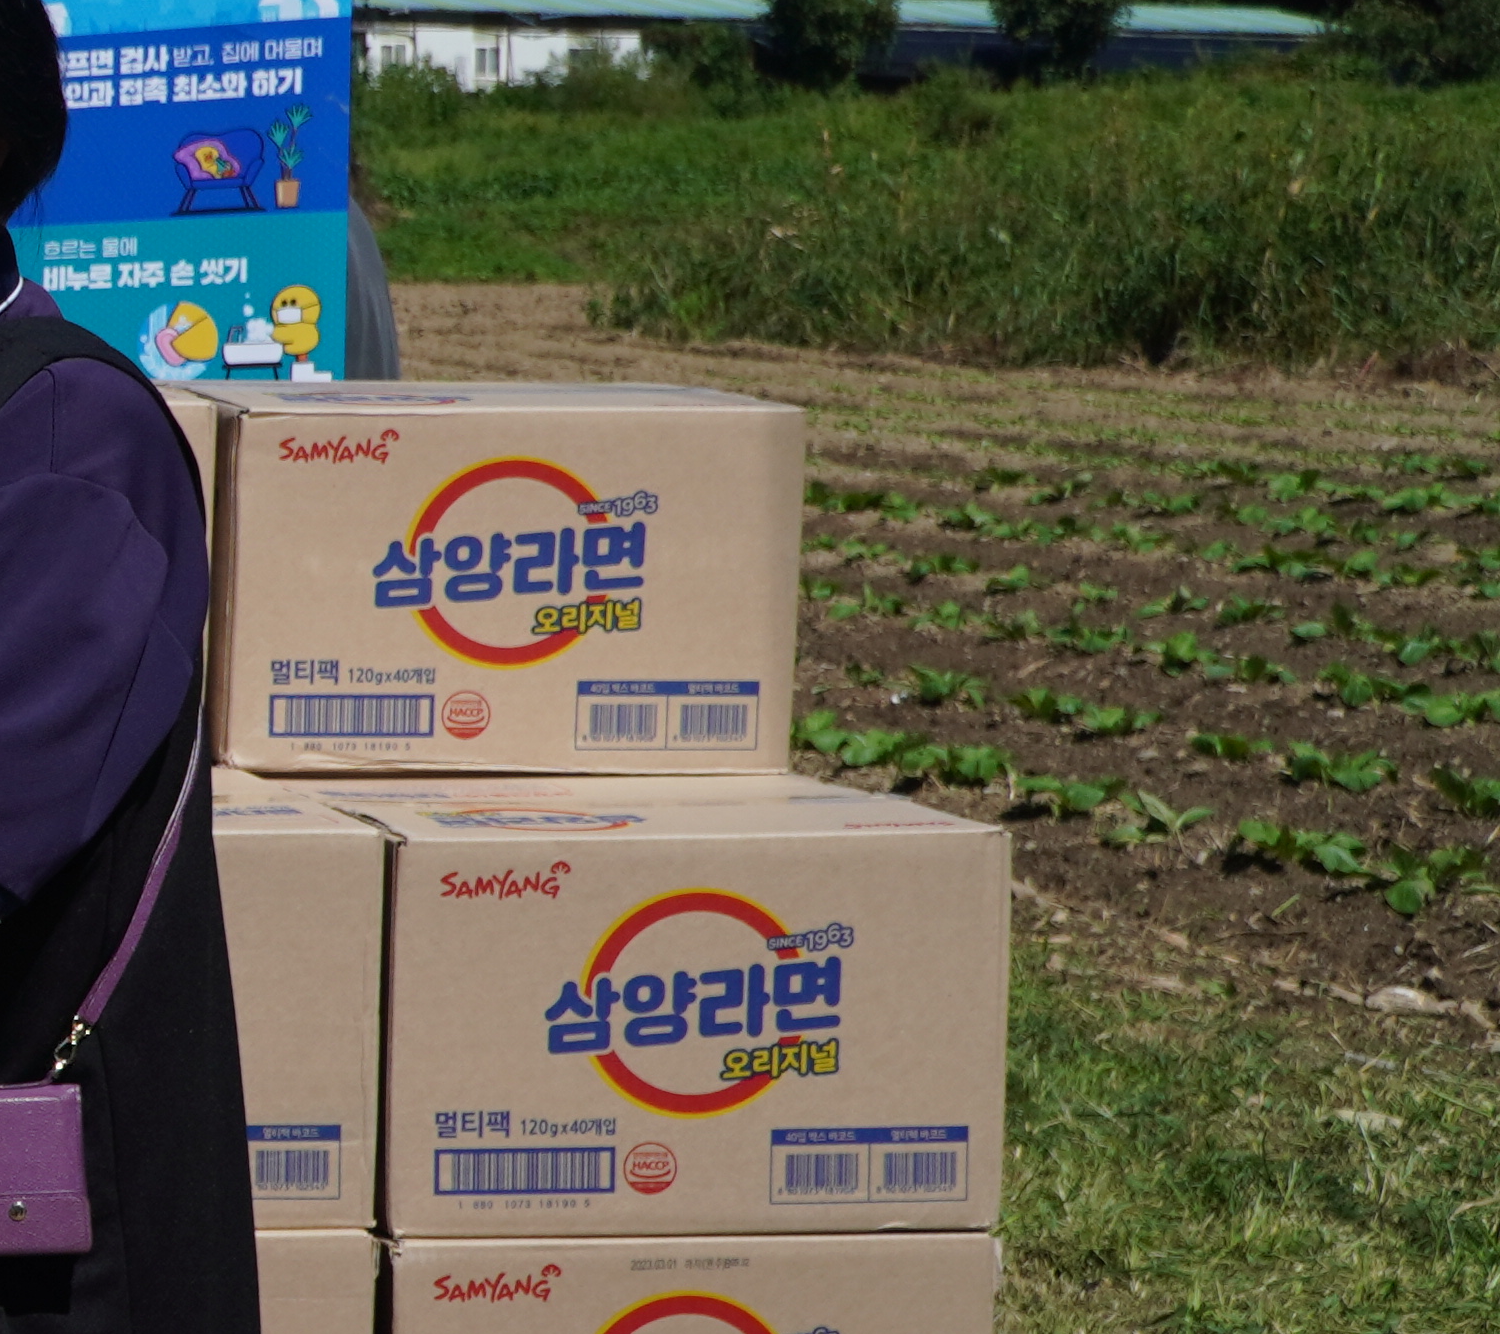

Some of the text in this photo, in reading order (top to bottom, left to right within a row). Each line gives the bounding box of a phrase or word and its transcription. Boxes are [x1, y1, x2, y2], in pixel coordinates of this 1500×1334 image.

[119, 45, 170, 75] 검사
[173, 44, 214, 67] 받고,
[222, 39, 259, 65] 집에
[265, 36, 323, 61] 머물며
[64, 79, 114, 109] 인과
[119, 75, 167, 107] 접촉
[252, 66, 302, 97] 하기
[44, 236, 138, 260] 흐르는 물에
[43, 257, 247, 291] 비누로 자주 손 씻기
[279, 436, 391, 464] SAMYANG
[579, 491, 658, 517] SINCE 1963
[372, 521, 647, 610] 삼양라면
[531, 599, 642, 635] 오리지널
[271, 659, 340, 685] 멀티팩
[449, 707, 484, 717] HACCP
[440, 868, 561, 900] SAMYANG
[767, 923, 854, 952] SINCE 1963
[545, 956, 842, 1055] 삼양라면
[720, 1038, 841, 1081] 오리지널
[435, 1111, 510, 1138] 멀티팩
[632, 1161, 670, 1171] HACCP
[433, 1272, 551, 1303] SAMYANG
